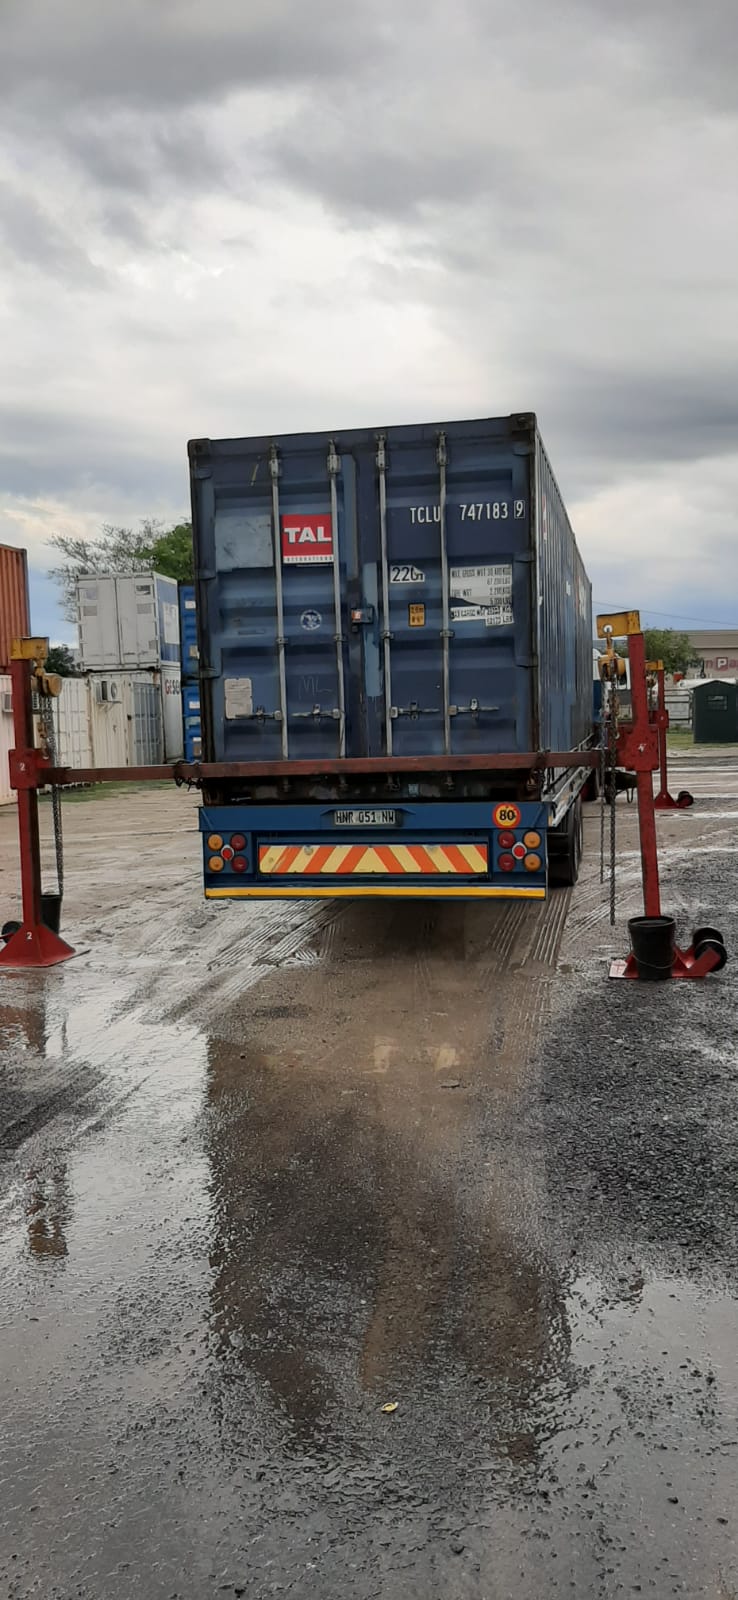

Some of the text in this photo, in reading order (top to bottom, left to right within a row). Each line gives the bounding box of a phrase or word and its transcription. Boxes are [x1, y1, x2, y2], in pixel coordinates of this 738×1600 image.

[410, 500, 524, 524] TCLU 747183 9
[283, 526, 332, 544] TAL
[19, 762, 26, 771] 2
[336, 810, 394, 824] HNR 051 NW
[499, 810, 515, 821] 80
[26, 931, 33, 940] 2
